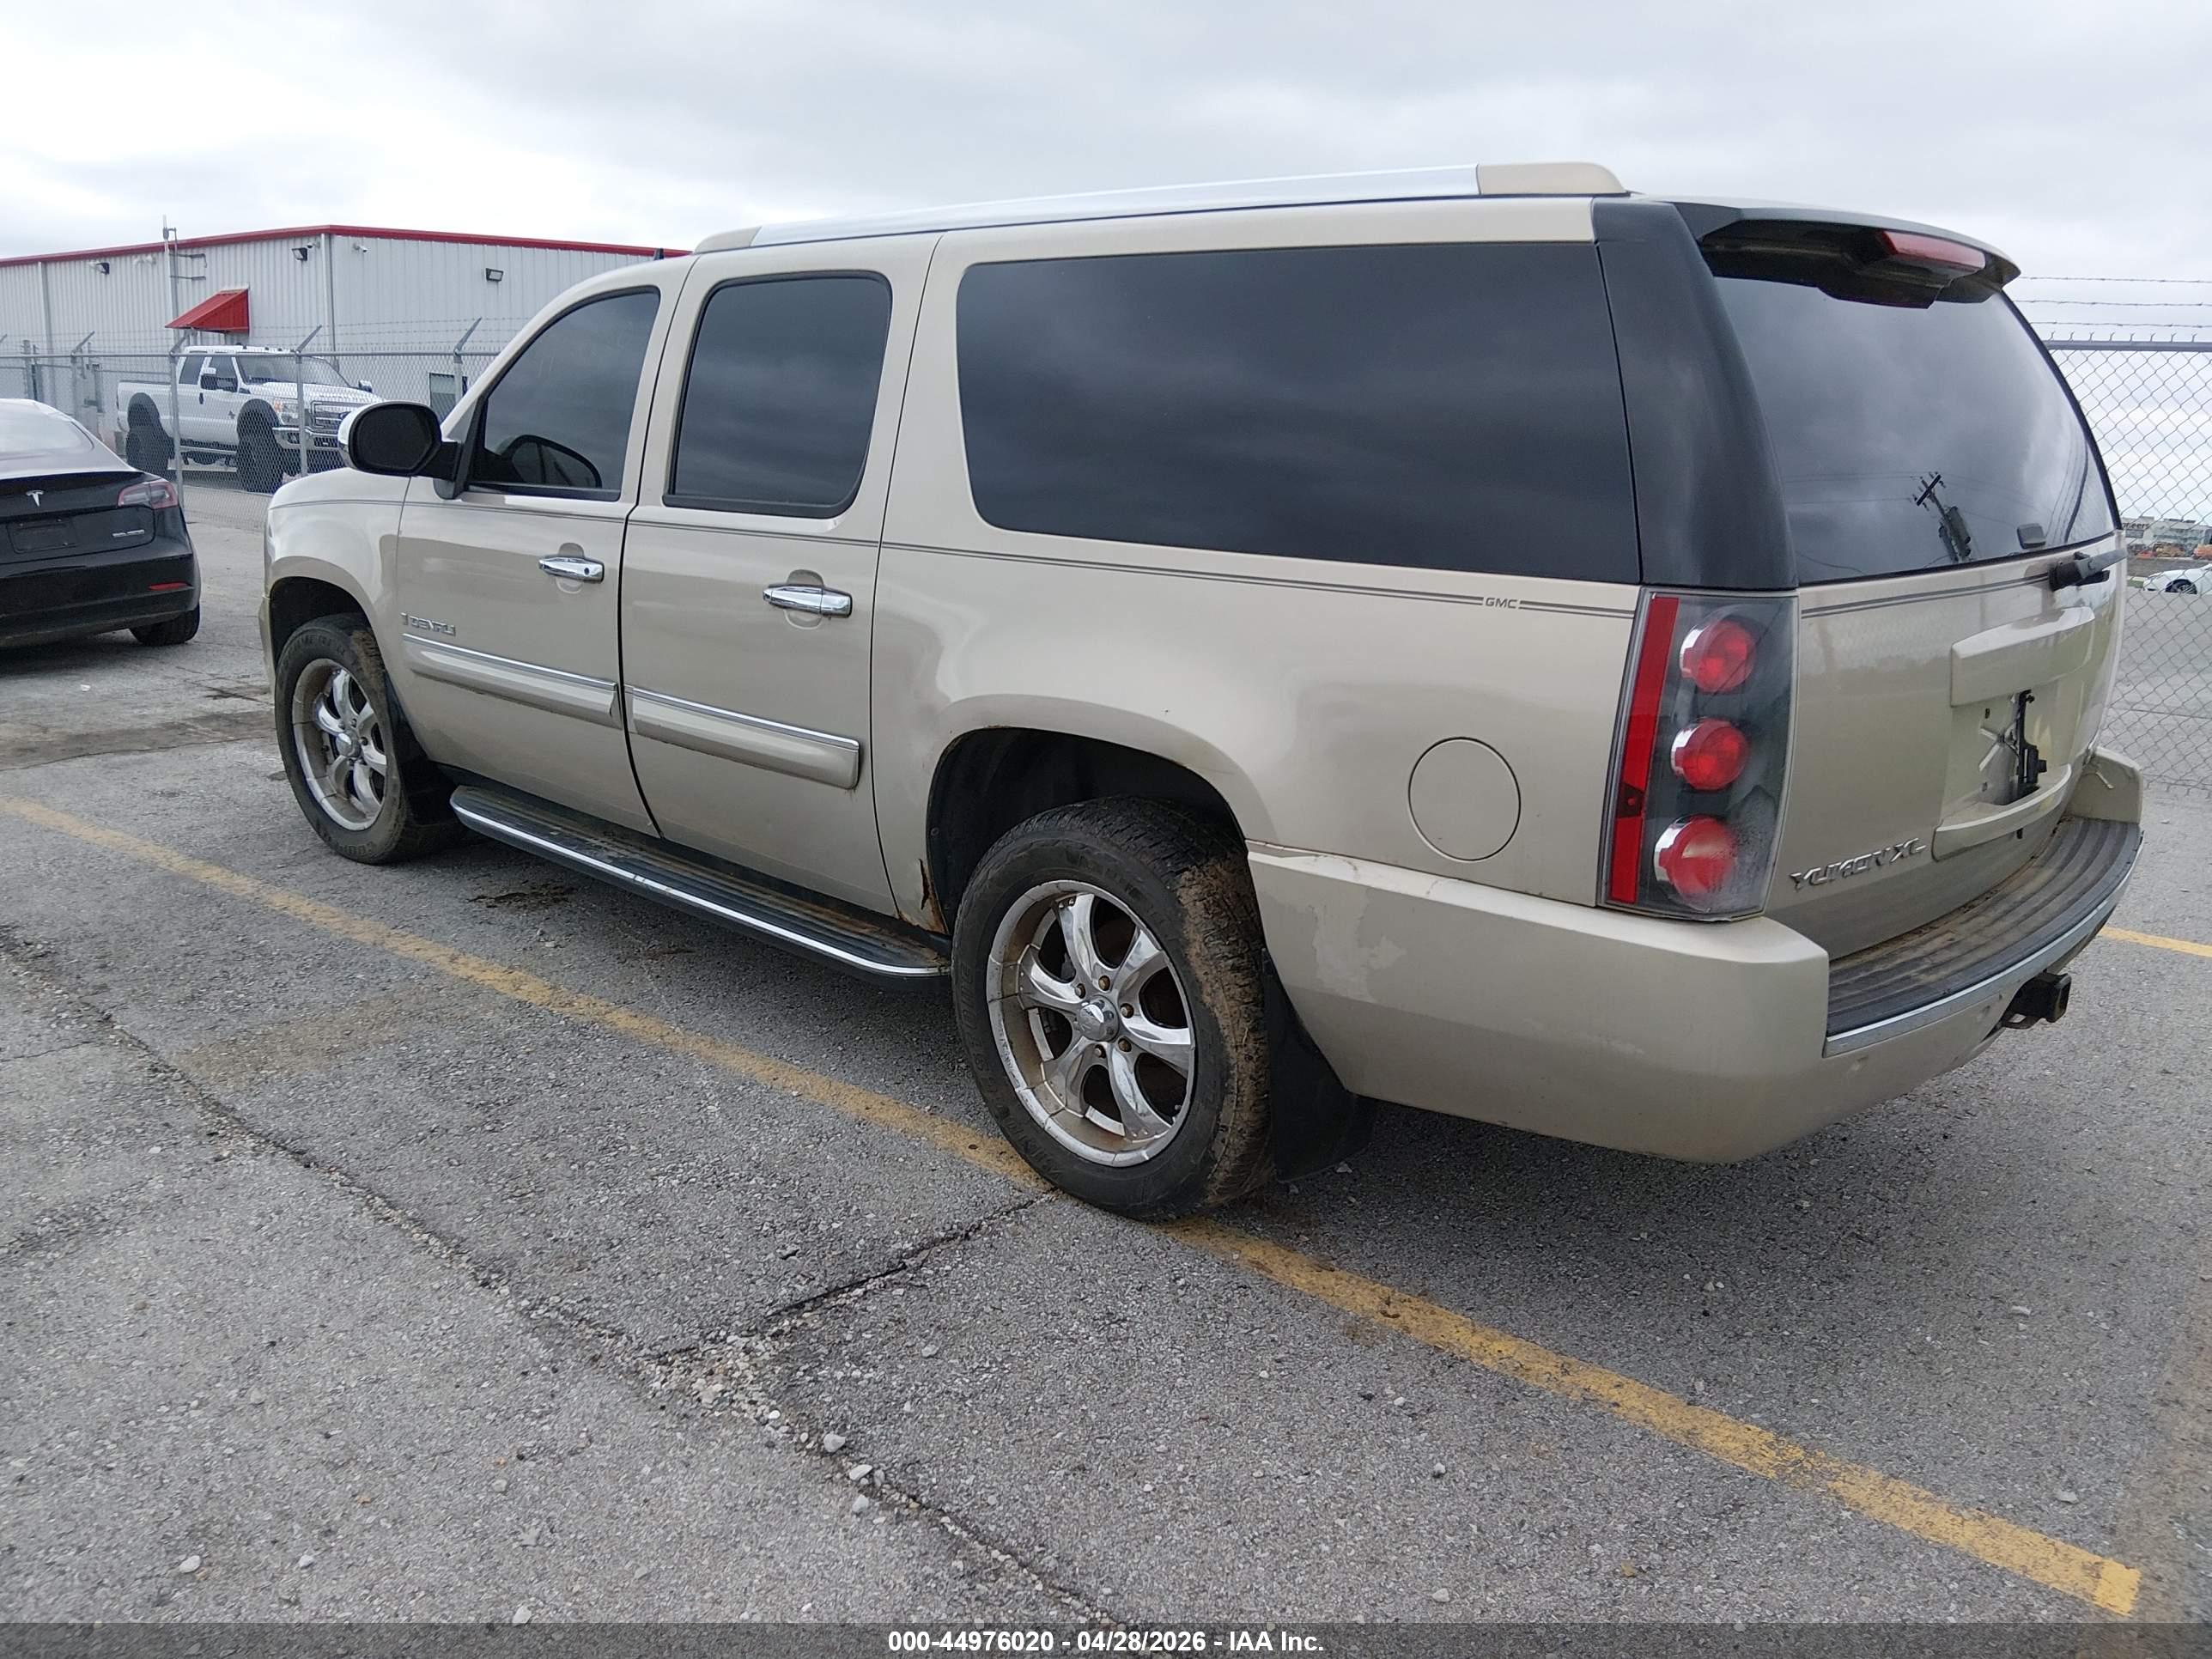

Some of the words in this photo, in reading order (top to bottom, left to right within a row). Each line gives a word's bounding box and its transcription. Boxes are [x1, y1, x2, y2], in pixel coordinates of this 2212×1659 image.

[1485, 597, 1518, 610] GMC
[409, 615, 456, 637] DENALI
[1790, 847, 1891, 891] YUKON
[1890, 837, 1927, 863] XL
